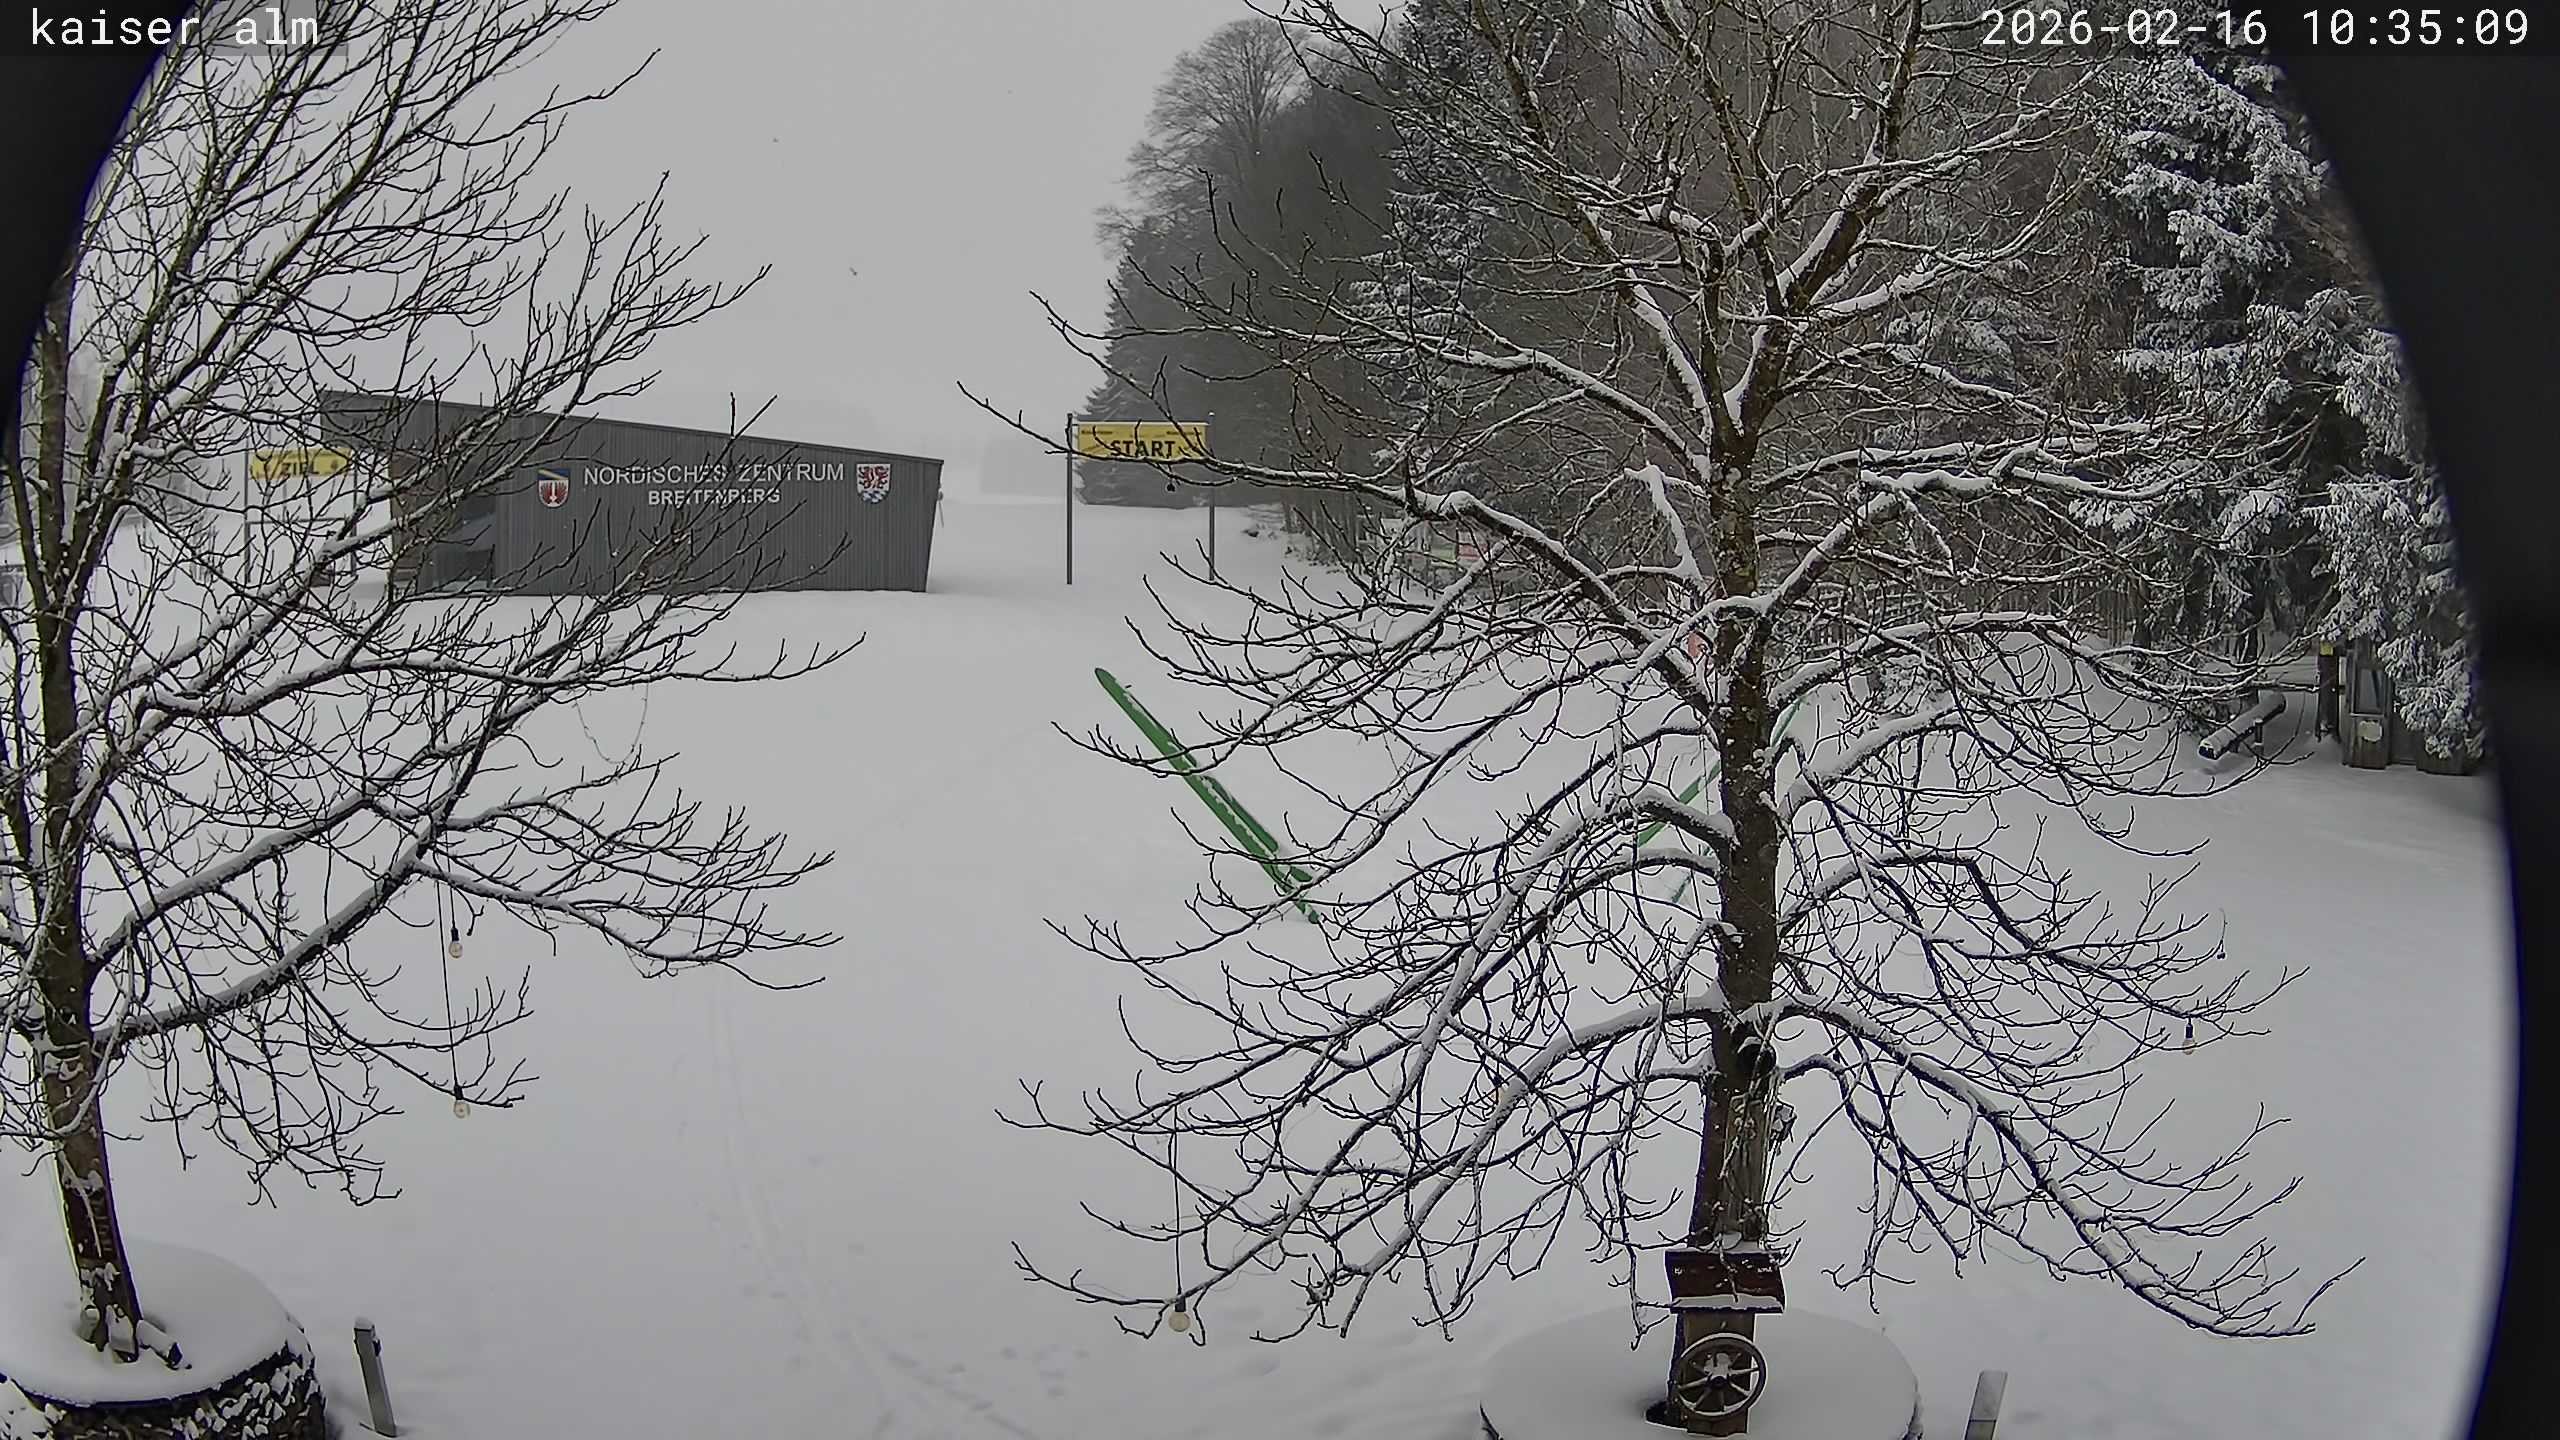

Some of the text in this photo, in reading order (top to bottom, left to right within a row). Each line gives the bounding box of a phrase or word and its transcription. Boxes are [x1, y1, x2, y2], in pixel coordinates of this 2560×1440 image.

[1110, 440, 1175, 457] START
[584, 463, 844, 485] NORDISCHES ZENTRUM
